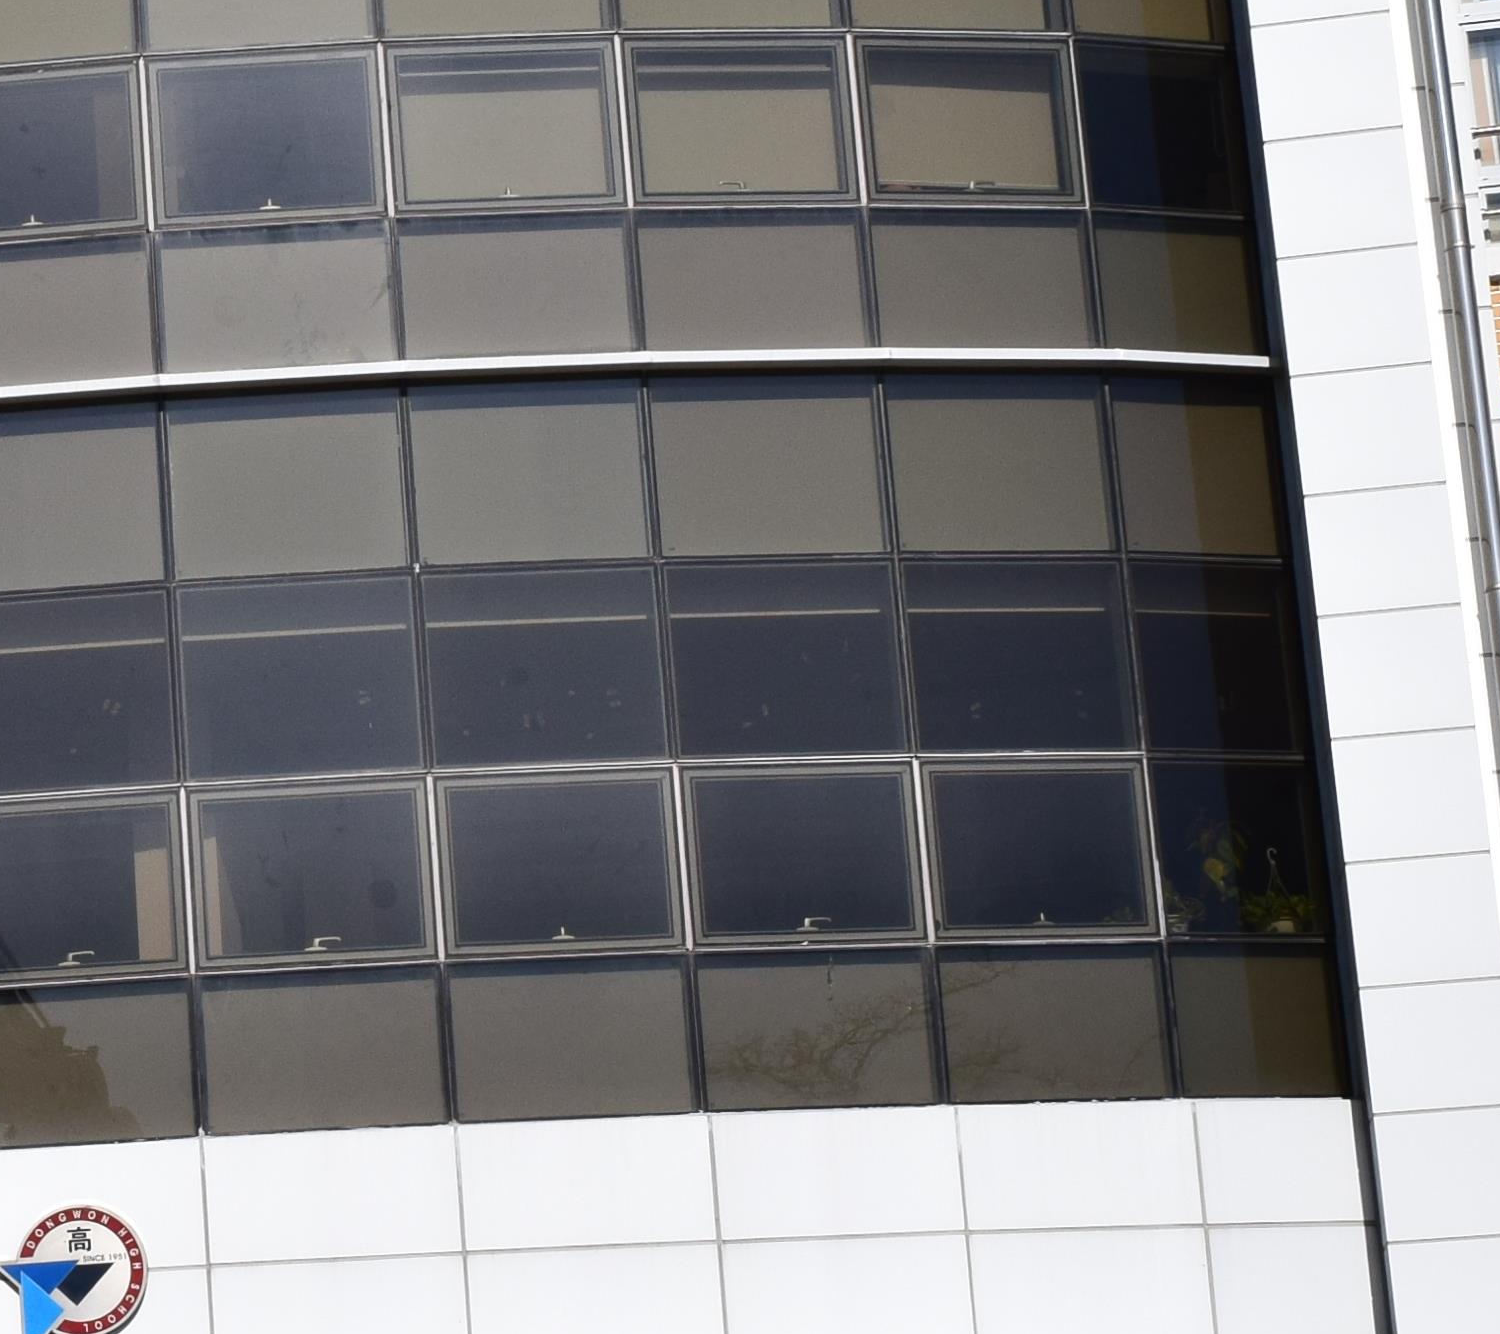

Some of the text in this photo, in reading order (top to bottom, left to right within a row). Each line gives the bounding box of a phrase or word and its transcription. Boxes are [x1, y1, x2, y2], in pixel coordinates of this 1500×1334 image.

[66, 1227, 92, 1253] 高
[82, 1254, 105, 1262] SINCE
[26, 1210, 142, 1333] DONGWON HIGH SCHOOL
